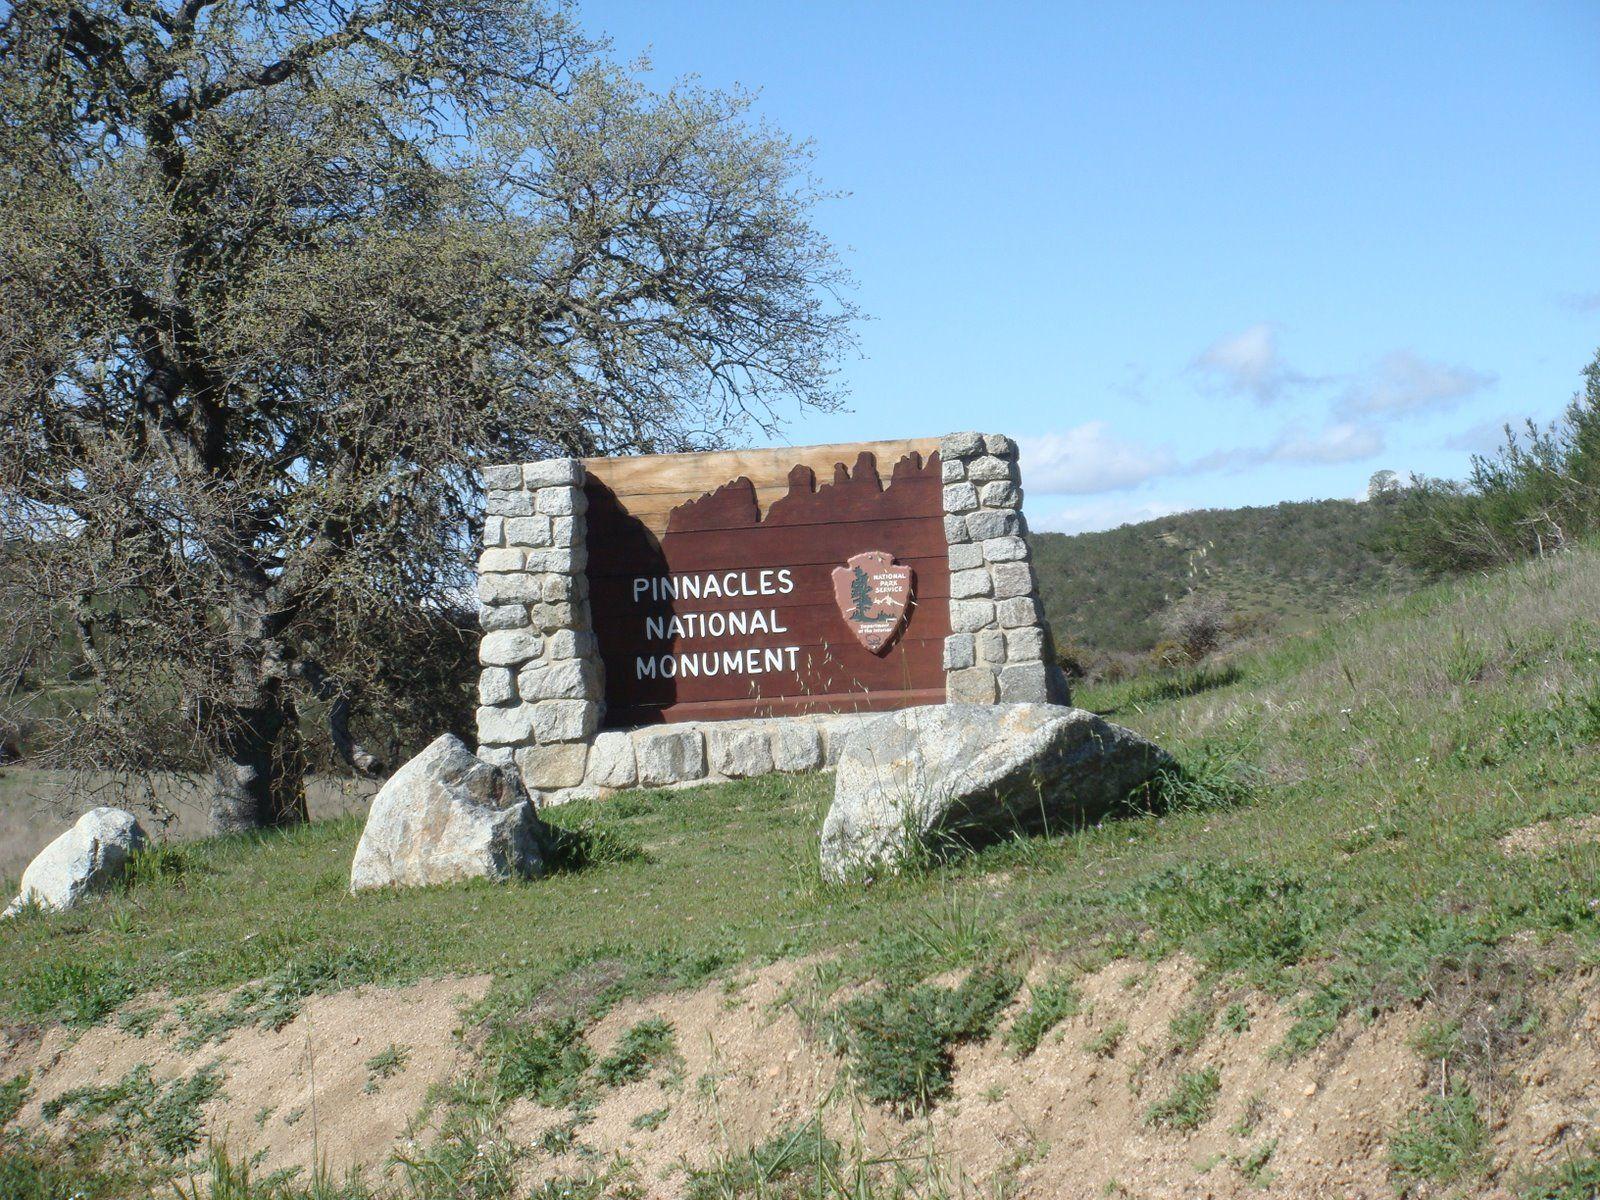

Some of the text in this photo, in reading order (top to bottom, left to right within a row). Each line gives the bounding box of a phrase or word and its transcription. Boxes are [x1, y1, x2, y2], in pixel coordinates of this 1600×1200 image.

[633, 569, 794, 603] PINNACLES
[646, 609, 788, 640] NATIONAL
[637, 647, 799, 680] MONUMENT
